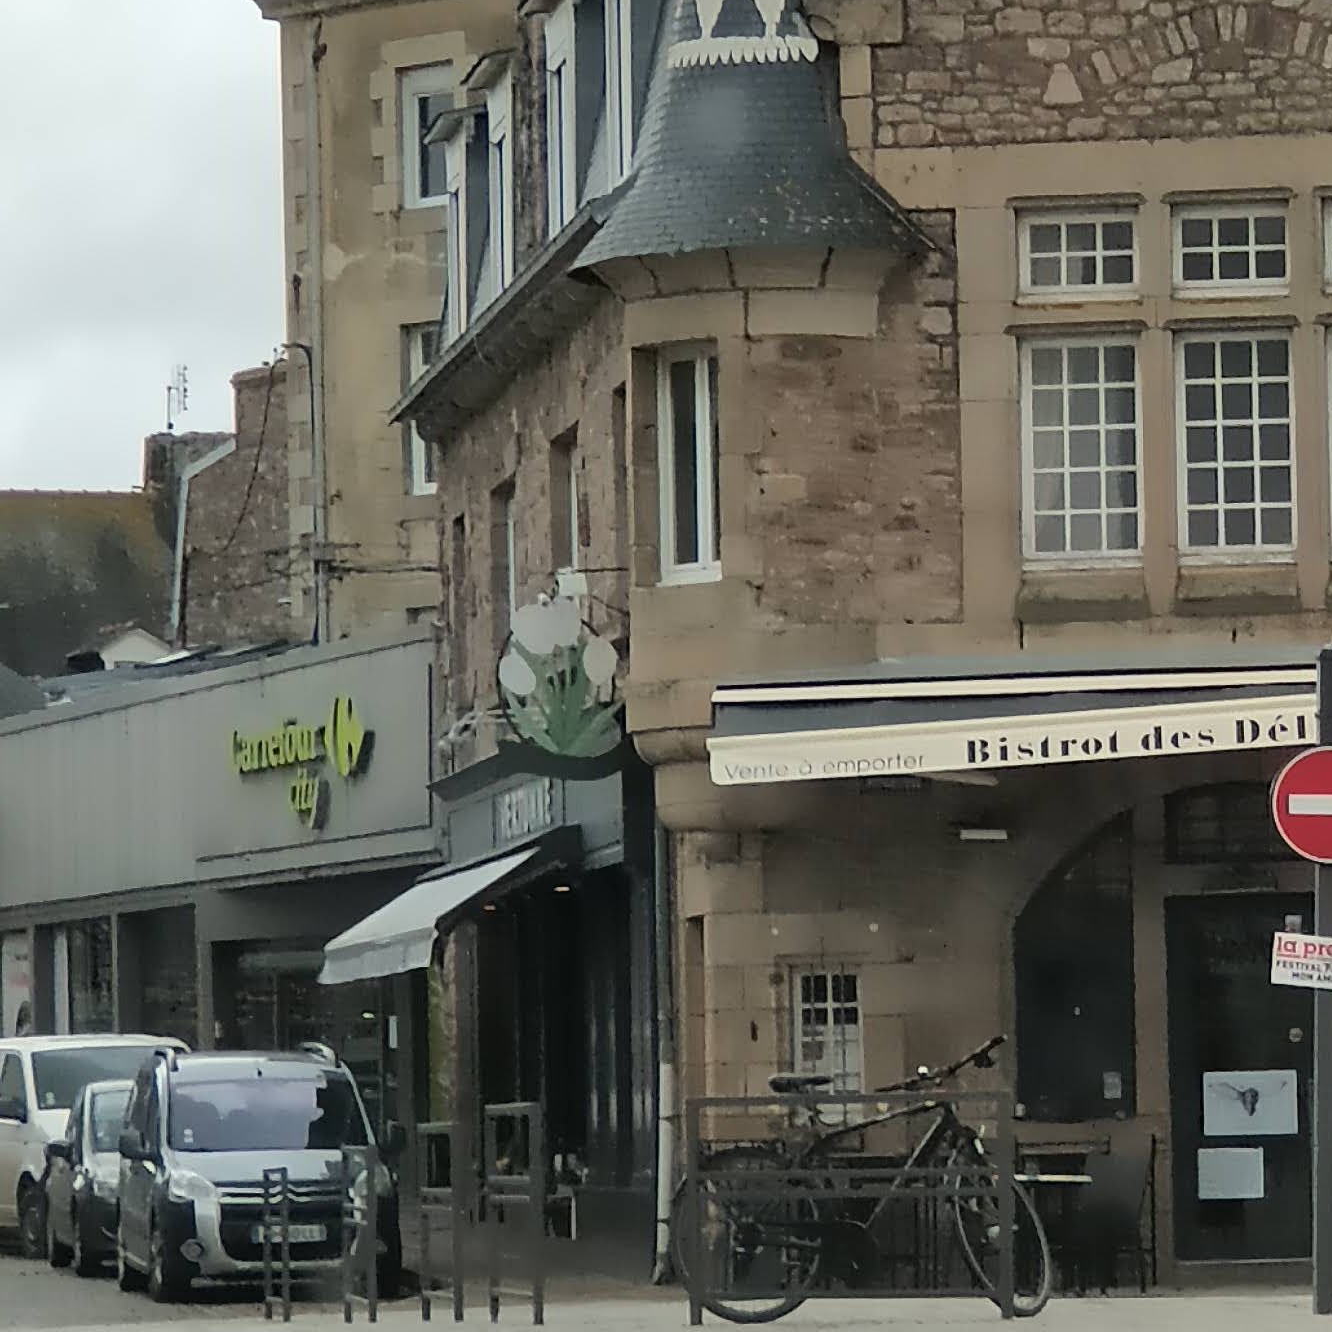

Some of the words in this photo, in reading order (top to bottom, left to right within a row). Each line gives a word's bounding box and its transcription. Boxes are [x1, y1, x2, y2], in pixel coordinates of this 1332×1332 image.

[966, 729, 1119, 764] Bistrot
[1140, 725, 1215, 750] des
[723, 763, 789, 780] Vente
[799, 759, 813, 775] à
[823, 753, 924, 773] emporter
[1276, 936, 1298, 954] la
